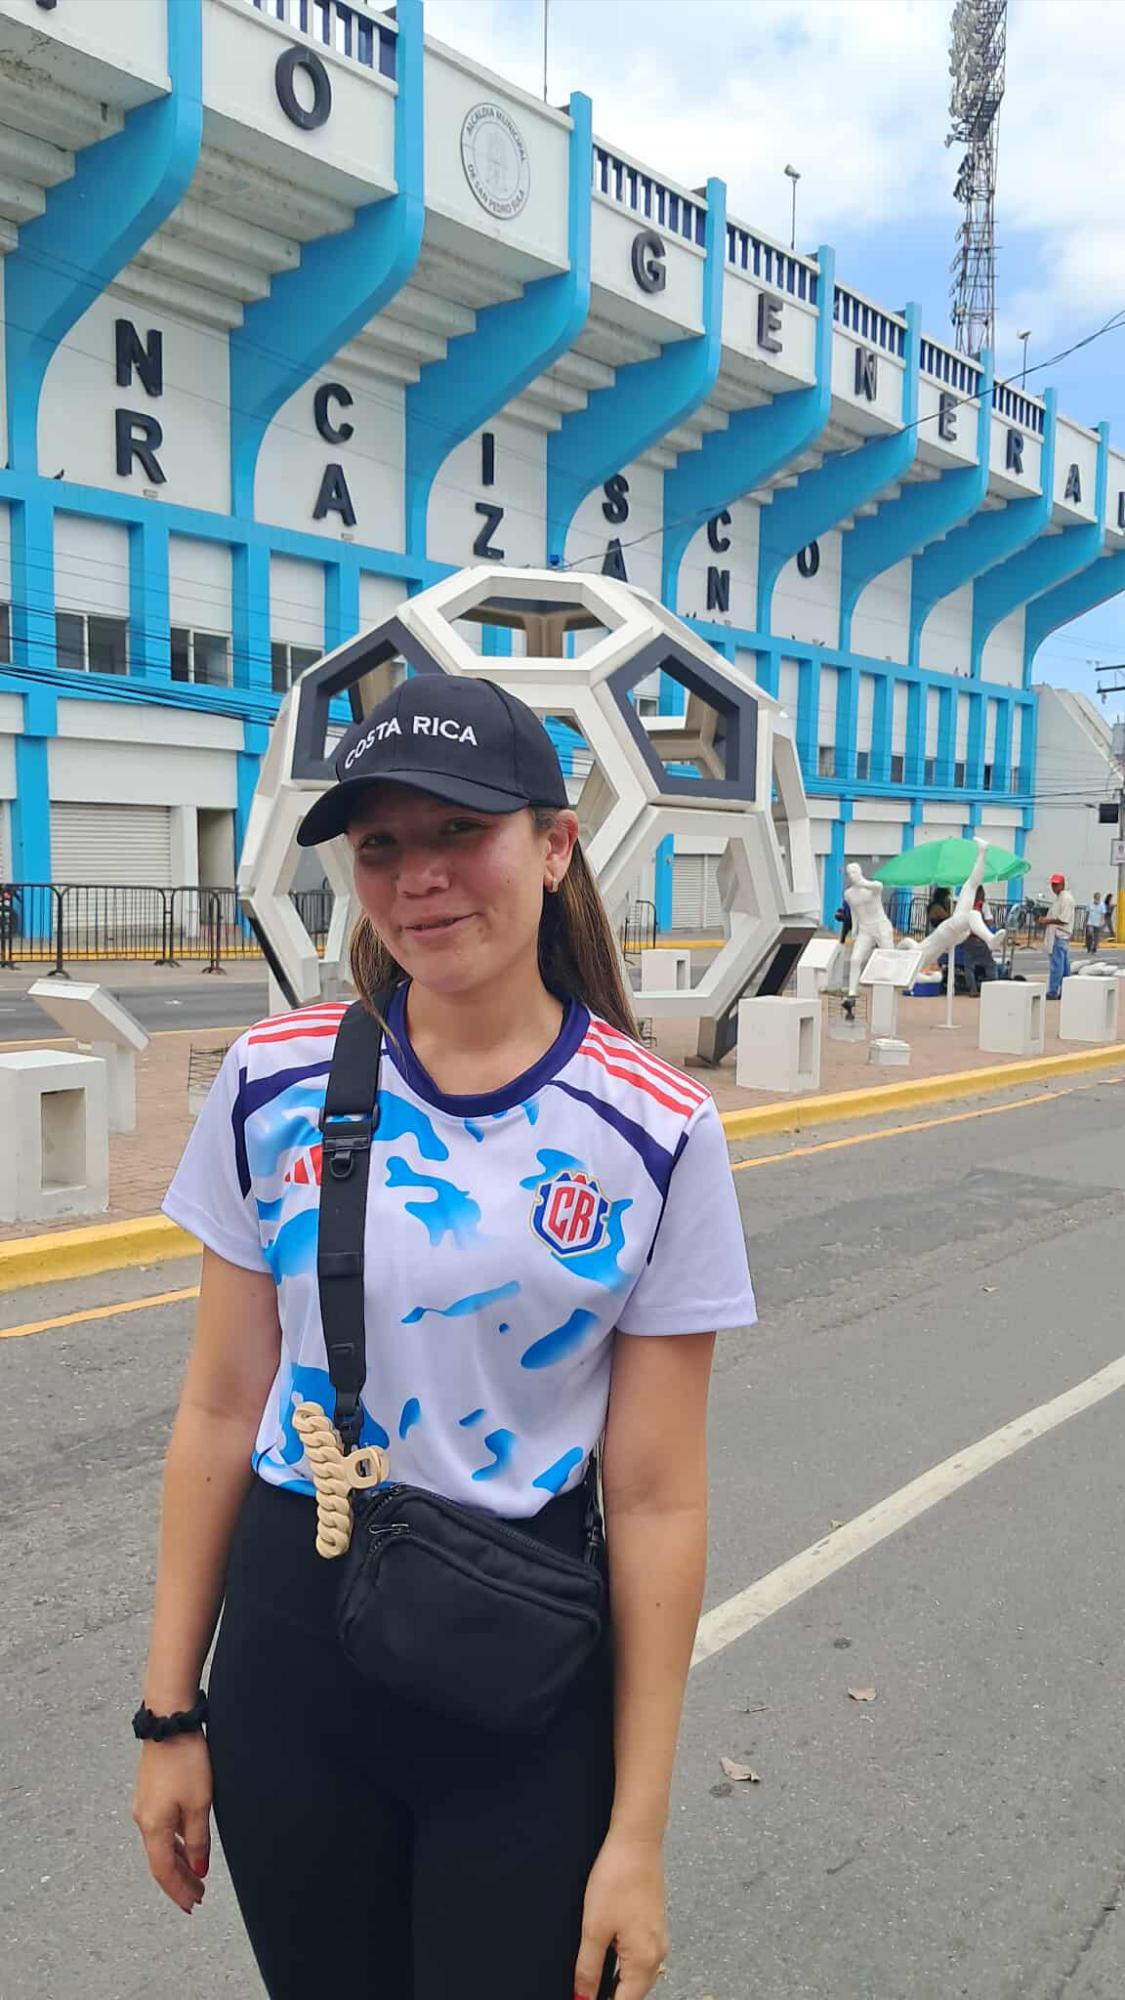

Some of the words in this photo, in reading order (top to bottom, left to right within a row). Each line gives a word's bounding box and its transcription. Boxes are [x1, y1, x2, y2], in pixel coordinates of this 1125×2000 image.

[275, 44, 332, 131] O
[345, 717, 402, 769] COSTA
[412, 715, 478, 746] RICA
[548, 1186, 595, 1242] CR
